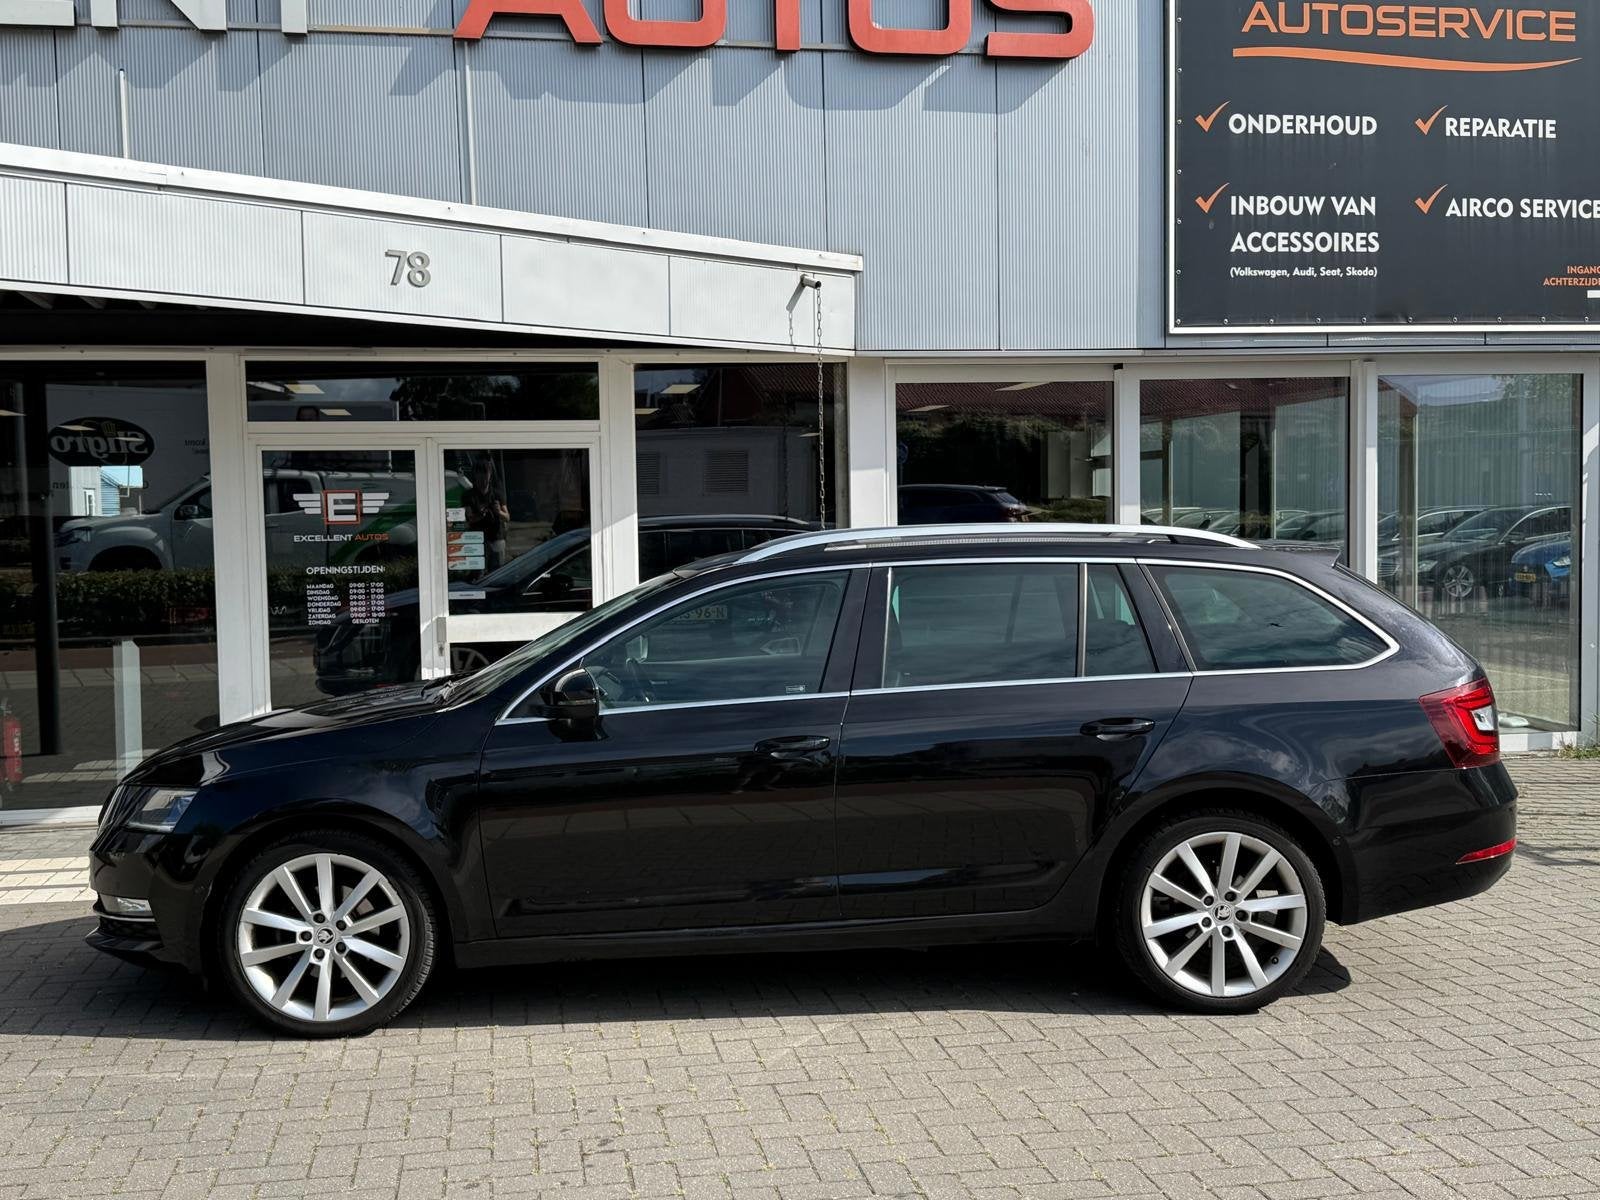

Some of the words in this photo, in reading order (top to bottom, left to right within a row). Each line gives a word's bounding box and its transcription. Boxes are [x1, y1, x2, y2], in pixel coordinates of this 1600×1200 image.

[1241, 1, 1576, 42] AUTOSERVICE
[1228, 113, 1378, 136] ONDERHOUD
[1445, 117, 1557, 139] REPARATIE
[1230, 195, 1326, 216] INBOUW
[1330, 196, 1376, 216] VAN
[1445, 197, 1514, 218] AIRCO
[1519, 198, 1600, 219] SERVICE
[1230, 231, 1380, 253] ACCESSOIRES
[384, 249, 431, 288] 78
[1229, 266, 1290, 278] (Volkswagen,
[1292, 266, 1317, 278] Audi,
[1319, 266, 1344, 278] Seat,
[1345, 266, 1378, 278] Skoda)
[1543, 277, 1600, 286] ACHTERZIJD
[293, 534, 353, 543] EXCELLENT
[354, 533, 389, 542] AUTOS
[306, 565, 386, 575] OPENINGSTIJDEN:
